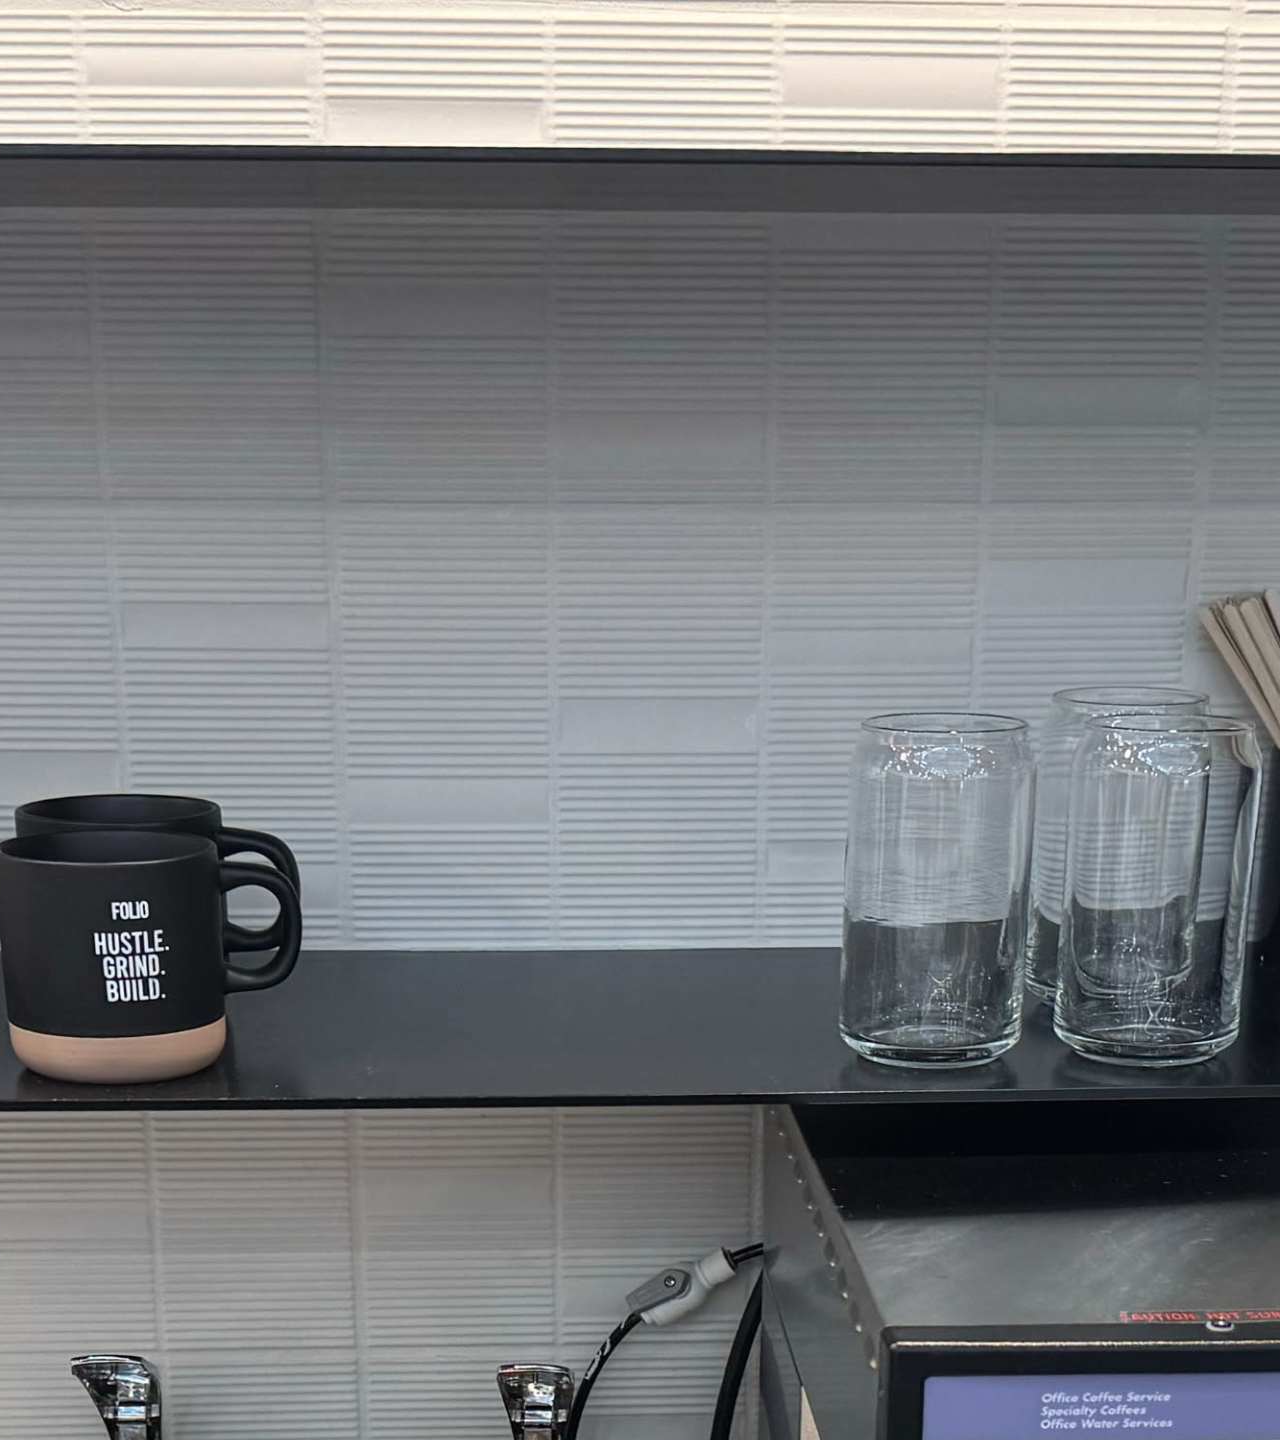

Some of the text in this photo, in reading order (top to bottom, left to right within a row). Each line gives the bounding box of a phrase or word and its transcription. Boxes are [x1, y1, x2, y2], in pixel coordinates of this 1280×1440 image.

[112, 902, 149, 920] FOLIO
[94, 930, 170, 955] HUSTLE.
[103, 954, 166, 978] GRIND.
[106, 977, 166, 1002] BUILD.
[1041, 1391, 1171, 1403] Office Coffee Service
[1040, 1405, 1146, 1417] Specialty Coffees
[1040, 1417, 1173, 1429] Office Water Services
